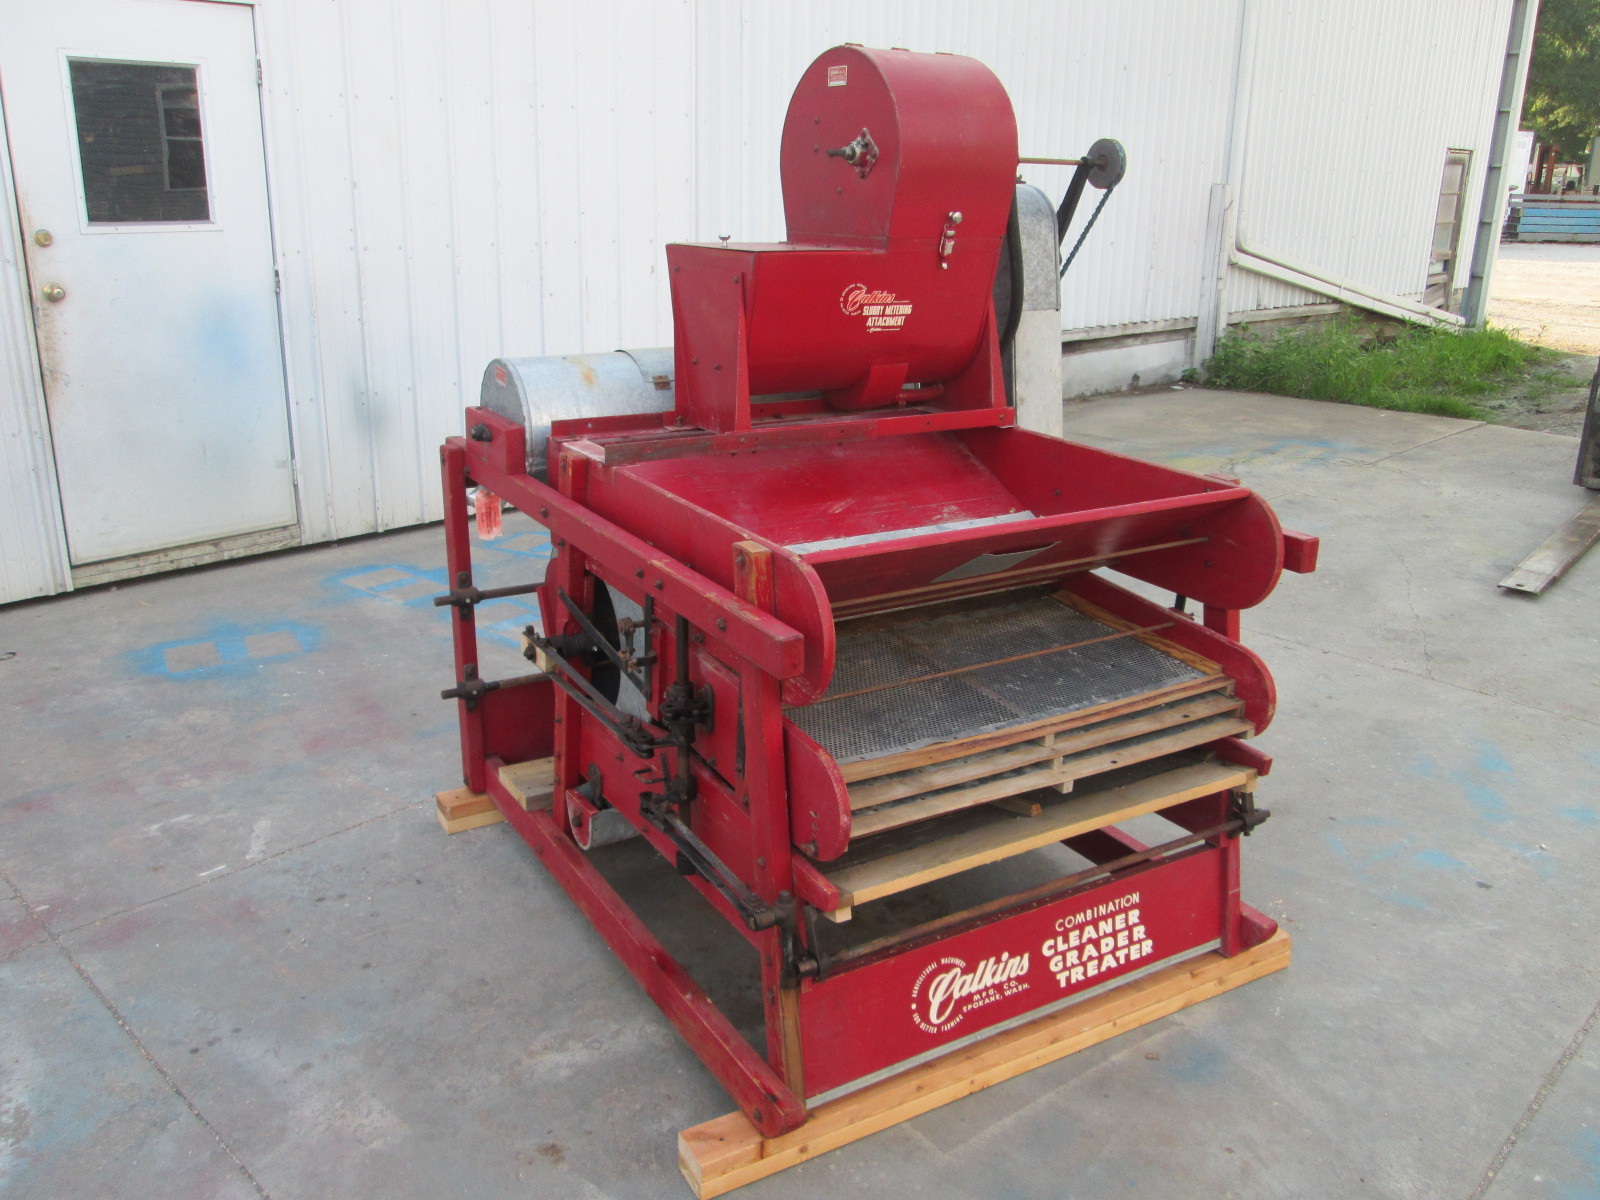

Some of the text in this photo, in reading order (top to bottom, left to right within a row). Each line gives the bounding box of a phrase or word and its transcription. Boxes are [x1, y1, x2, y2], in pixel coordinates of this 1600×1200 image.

[862, 305, 885, 316] SLURRY
[884, 304, 913, 315] METERING
[866, 316, 906, 327] ATTACHMENT
[1055, 891, 1140, 932] COMBINATION
[1041, 909, 1140, 957] CLEANER
[1049, 925, 1147, 973] GRADER
[911, 957, 967, 998] AGRICULTURAL MACHINERY
[1056, 939, 1154, 988] TREATER
[929, 951, 1030, 1025] Calkins
[1003, 980, 1019, 990] CO.
[1004, 983, 1031, 997] WASH.
[919, 1022, 938, 1034] BETTER
[941, 1013, 964, 1032] FARMING
